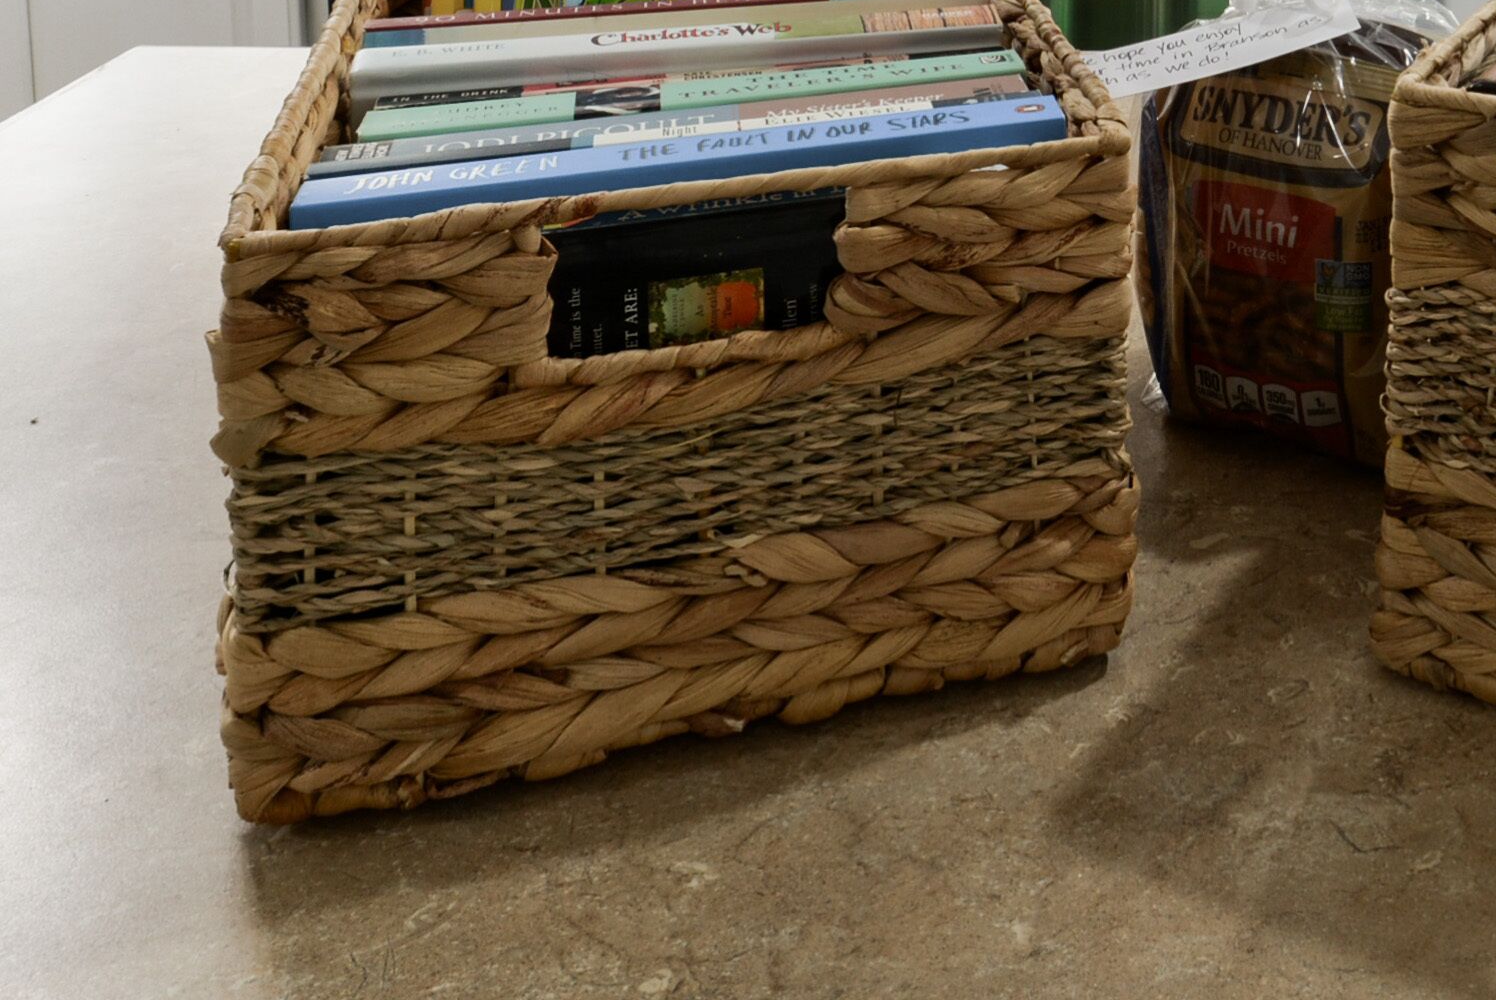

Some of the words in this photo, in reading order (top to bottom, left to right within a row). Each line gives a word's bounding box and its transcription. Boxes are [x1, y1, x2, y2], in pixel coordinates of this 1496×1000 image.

[475, 4, 624, 20] MINUTES
[643, 0, 674, 9] IN
[590, 25, 729, 47] Charlotte's
[732, 21, 793, 36] Web
[1103, 47, 1145, 63] hope
[1196, 23, 1243, 44] enjoy
[1116, 56, 1161, 72] time
[1174, 50, 1193, 60] in
[1298, 17, 1323, 29] as
[1126, 71, 1152, 82] as
[1198, 51, 1230, 68] do!
[423, 92, 450, 100] THE
[460, 87, 509, 97] DRINK
[536, 113, 716, 142] PICOULT
[662, 125, 699, 137] Night
[1193, 84, 1371, 148] SNYDER'S
[620, 142, 679, 161] THE
[696, 131, 770, 153] FAULT
[788, 126, 814, 143] IN
[826, 121, 872, 139] OUR
[888, 111, 970, 131] STARS
[1218, 127, 1241, 144] OF
[1242, 132, 1323, 161] HANOVER
[345, 169, 433, 194] JOHN
[449, 155, 559, 182] GREEN
[1219, 202, 1299, 249] Mini
[1227, 239, 1288, 265] Pretzels
